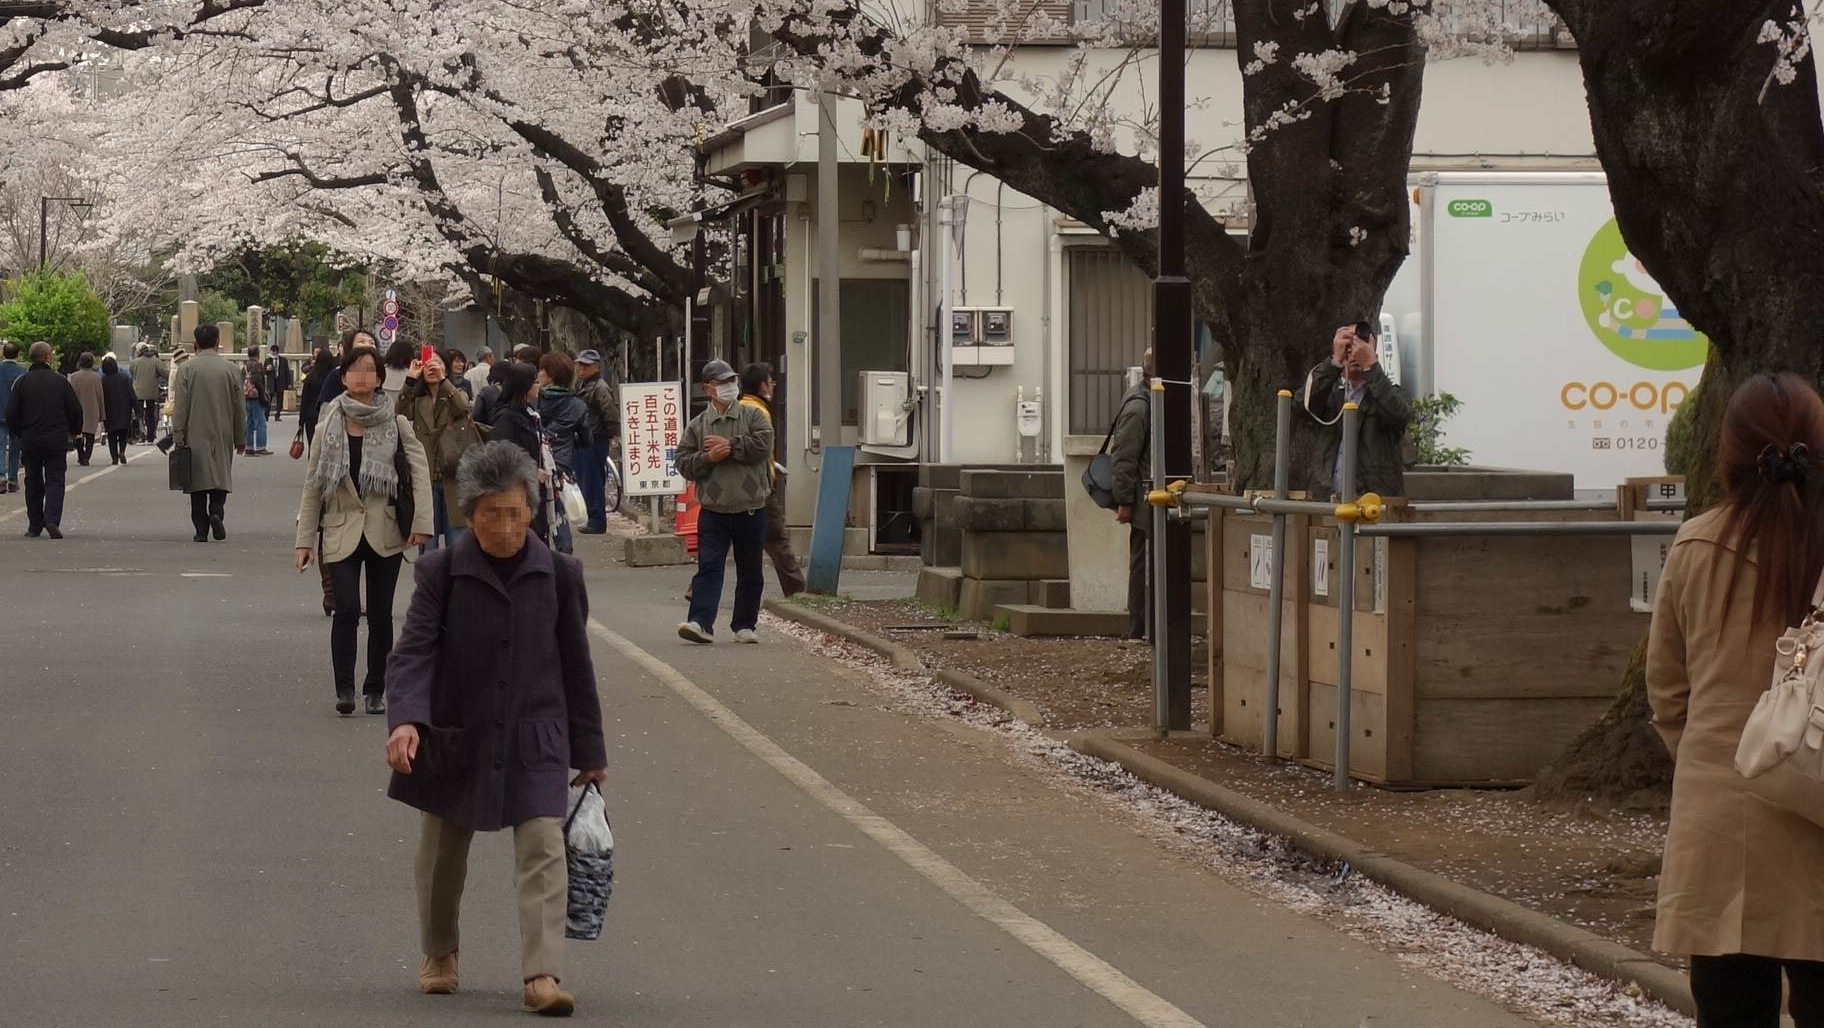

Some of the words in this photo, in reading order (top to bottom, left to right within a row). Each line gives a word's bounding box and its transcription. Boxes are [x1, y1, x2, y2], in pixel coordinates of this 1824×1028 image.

[1501, 211, 1565, 223] コープみらい
[626, 400, 642, 476] 行き止まり
[644, 394, 661, 470] 百五十米先
[663, 387, 679, 478] この道路車は
[639, 479, 671, 490] 東京都
